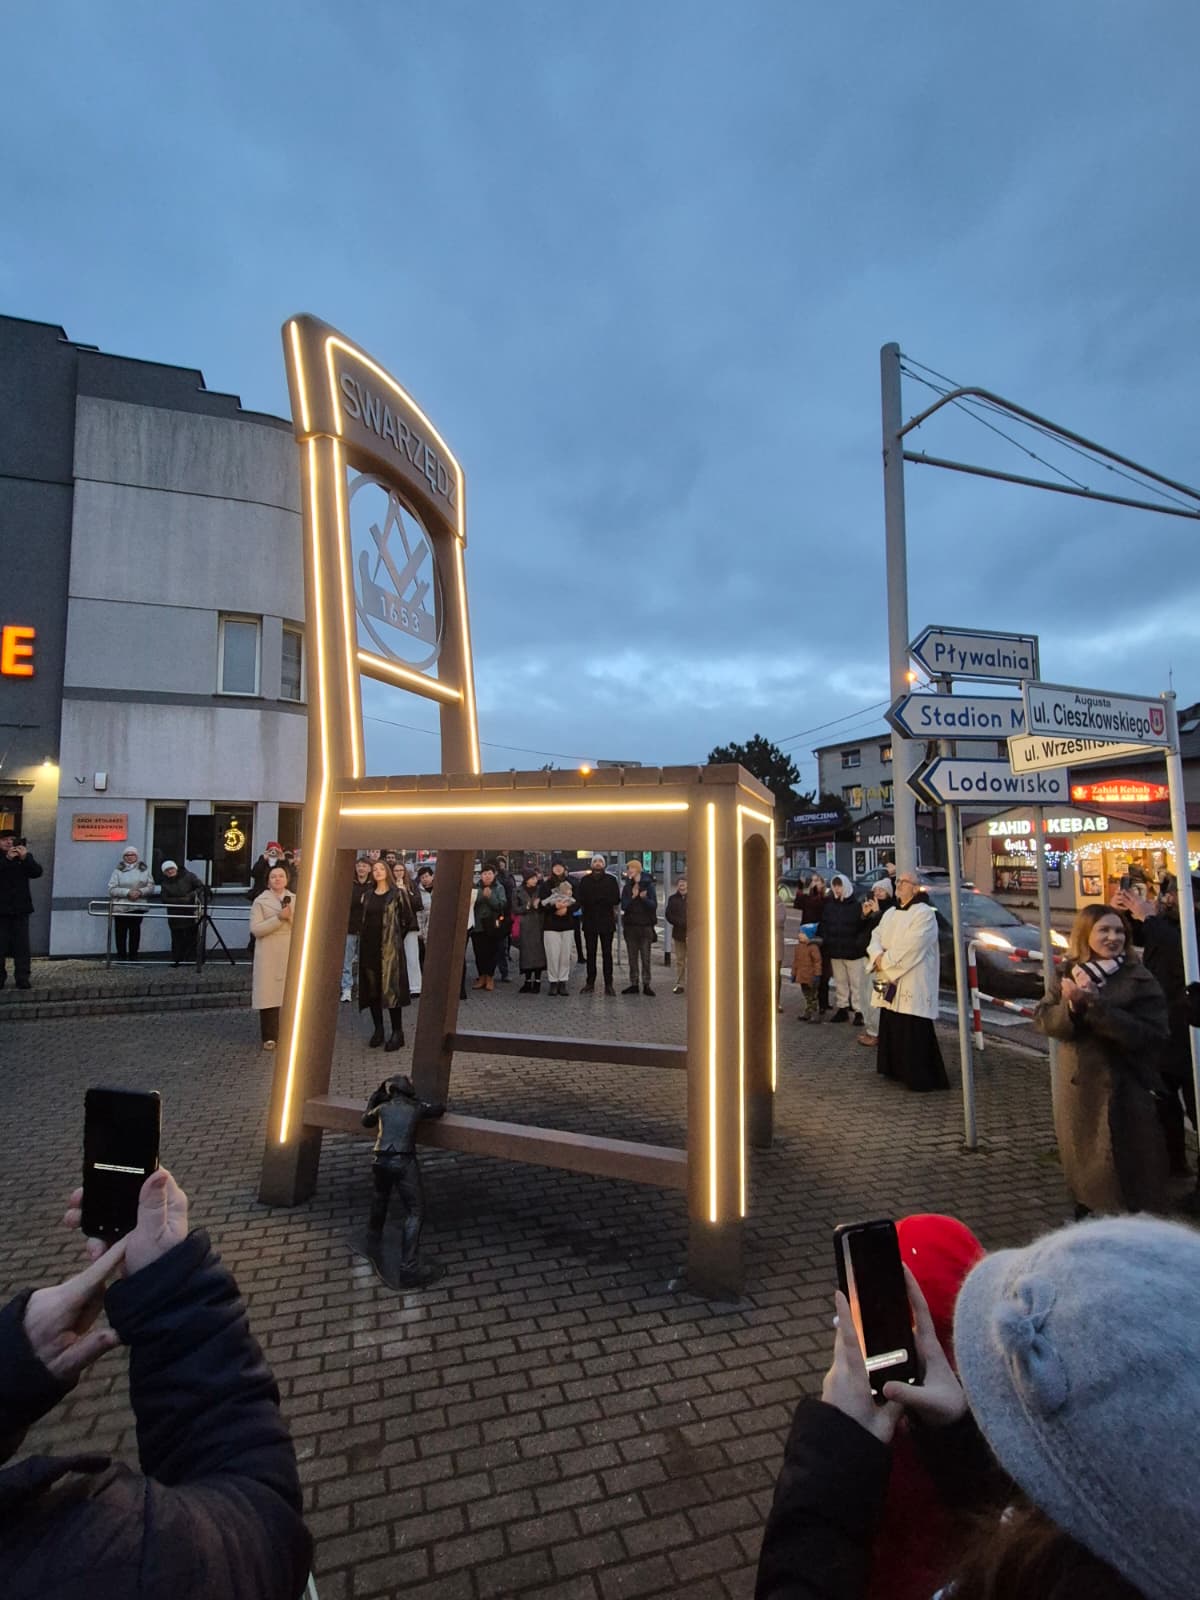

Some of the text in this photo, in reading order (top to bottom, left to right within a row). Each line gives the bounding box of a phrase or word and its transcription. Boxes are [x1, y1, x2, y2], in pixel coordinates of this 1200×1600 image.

[340, 373, 457, 507] SWARZĘDZ
[1, 625, 36, 675] E
[935, 643, 1029, 670] Pływalnia
[1074, 695, 1111, 708] Augusta
[921, 705, 1025, 728] Stadion M
[1033, 702, 1150, 737] ul. Cieszkowskiego
[1025, 745, 1039, 761] ul.
[948, 771, 1060, 794] Lodowisko
[1120, 785, 1150, 794] Kebab
[988, 817, 1109, 835] ZAHID KEBAB
[868, 835, 895, 845] KANTO
